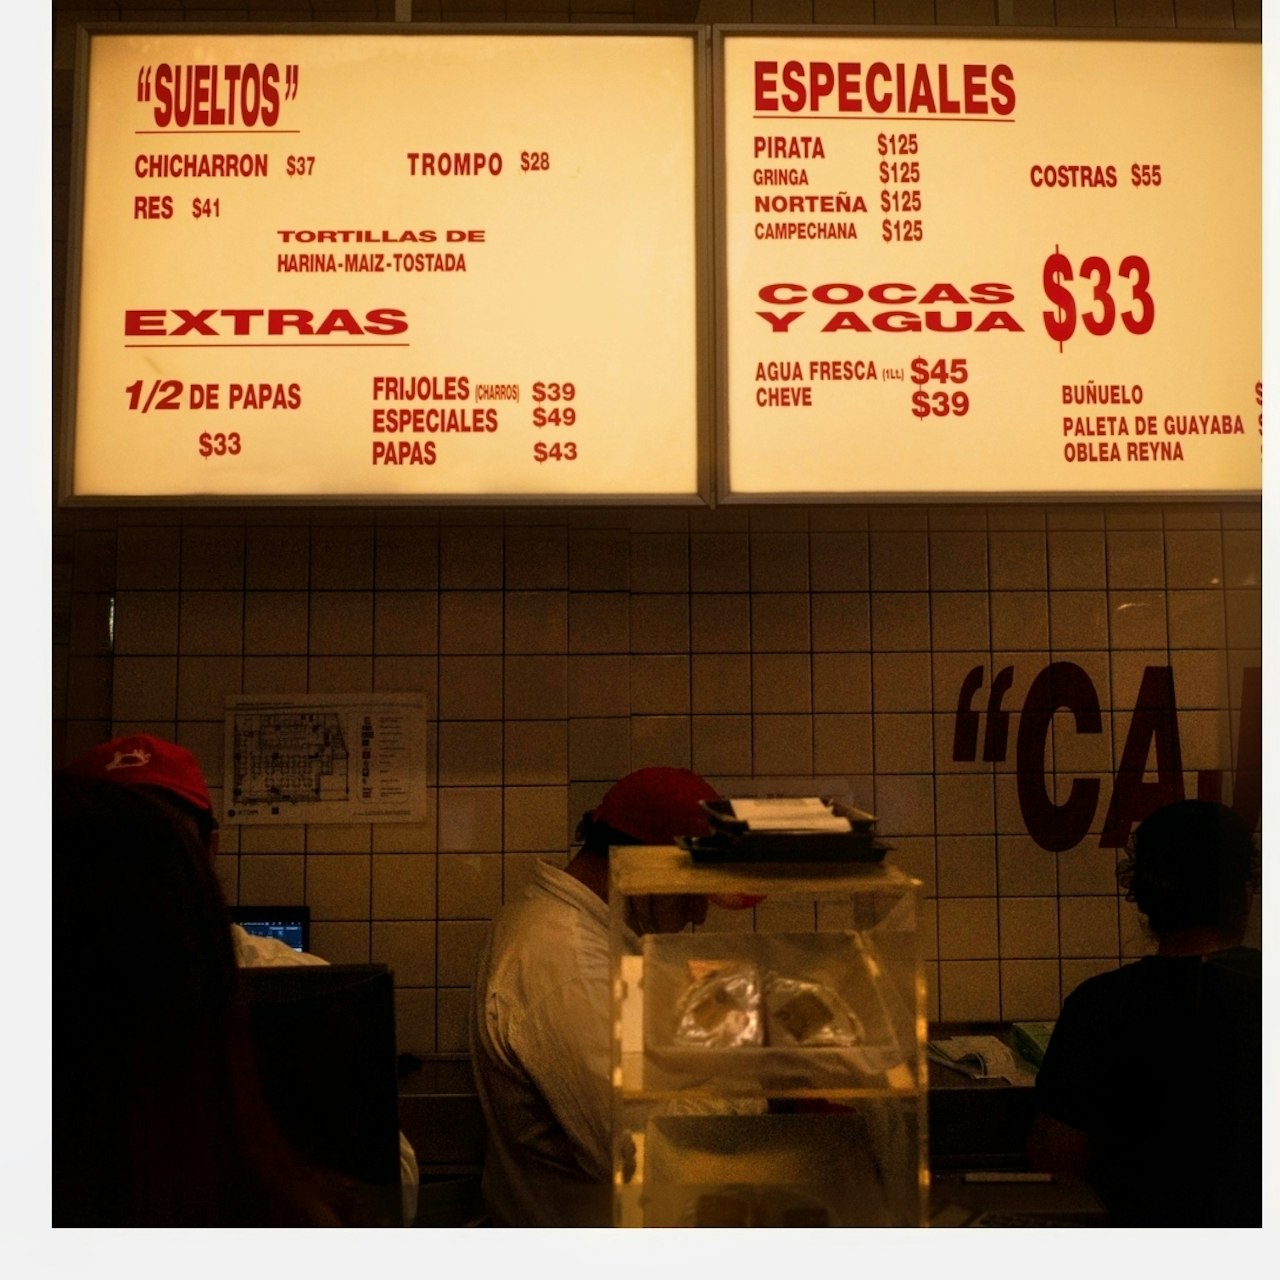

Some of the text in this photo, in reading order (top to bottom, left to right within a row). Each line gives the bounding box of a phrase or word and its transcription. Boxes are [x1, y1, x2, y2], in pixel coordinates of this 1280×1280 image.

[754, 60, 1016, 116] ESPECIALES
[754, 130, 919, 159] PIRATA $125
[134, 154, 316, 178] CHICHARRON $37
[407, 150, 550, 176] TROMPO $28
[753, 160, 921, 186] GRINGA $125
[1030, 161, 1162, 188] COSTRAS $55
[134, 195, 220, 219] RES $41
[754, 188, 922, 214] NORTEÑA $125
[277, 230, 486, 243] TORTILLAS DE
[754, 218, 923, 243] CAMPECHANA $125
[758, 282, 1015, 305] COCAS
[1042, 244, 1155, 354] $33
[124, 308, 408, 336] EXTRAS
[755, 311, 1026, 333] Y AGUA
[755, 361, 804, 381] AGUA
[809, 360, 878, 380] FRESCA
[910, 355, 969, 386] $45
[125, 380, 302, 413] 1/2 DE PAPAS
[373, 376, 576, 403] FRIJOLES (CHARROS) $39
[1062, 380, 1143, 405] BUÑUELO
[756, 387, 970, 420] CHEVE $39
[372, 405, 576, 433] ESPECIALES $49
[1063, 416, 1129, 436] PALETA
[1135, 416, 1158, 435] DE
[1164, 415, 1245, 435] GUAYABA
[199, 430, 241, 460] $33
[372, 440, 578, 465] PAPAS $43
[1064, 441, 1184, 462] OBLEA REYNA
